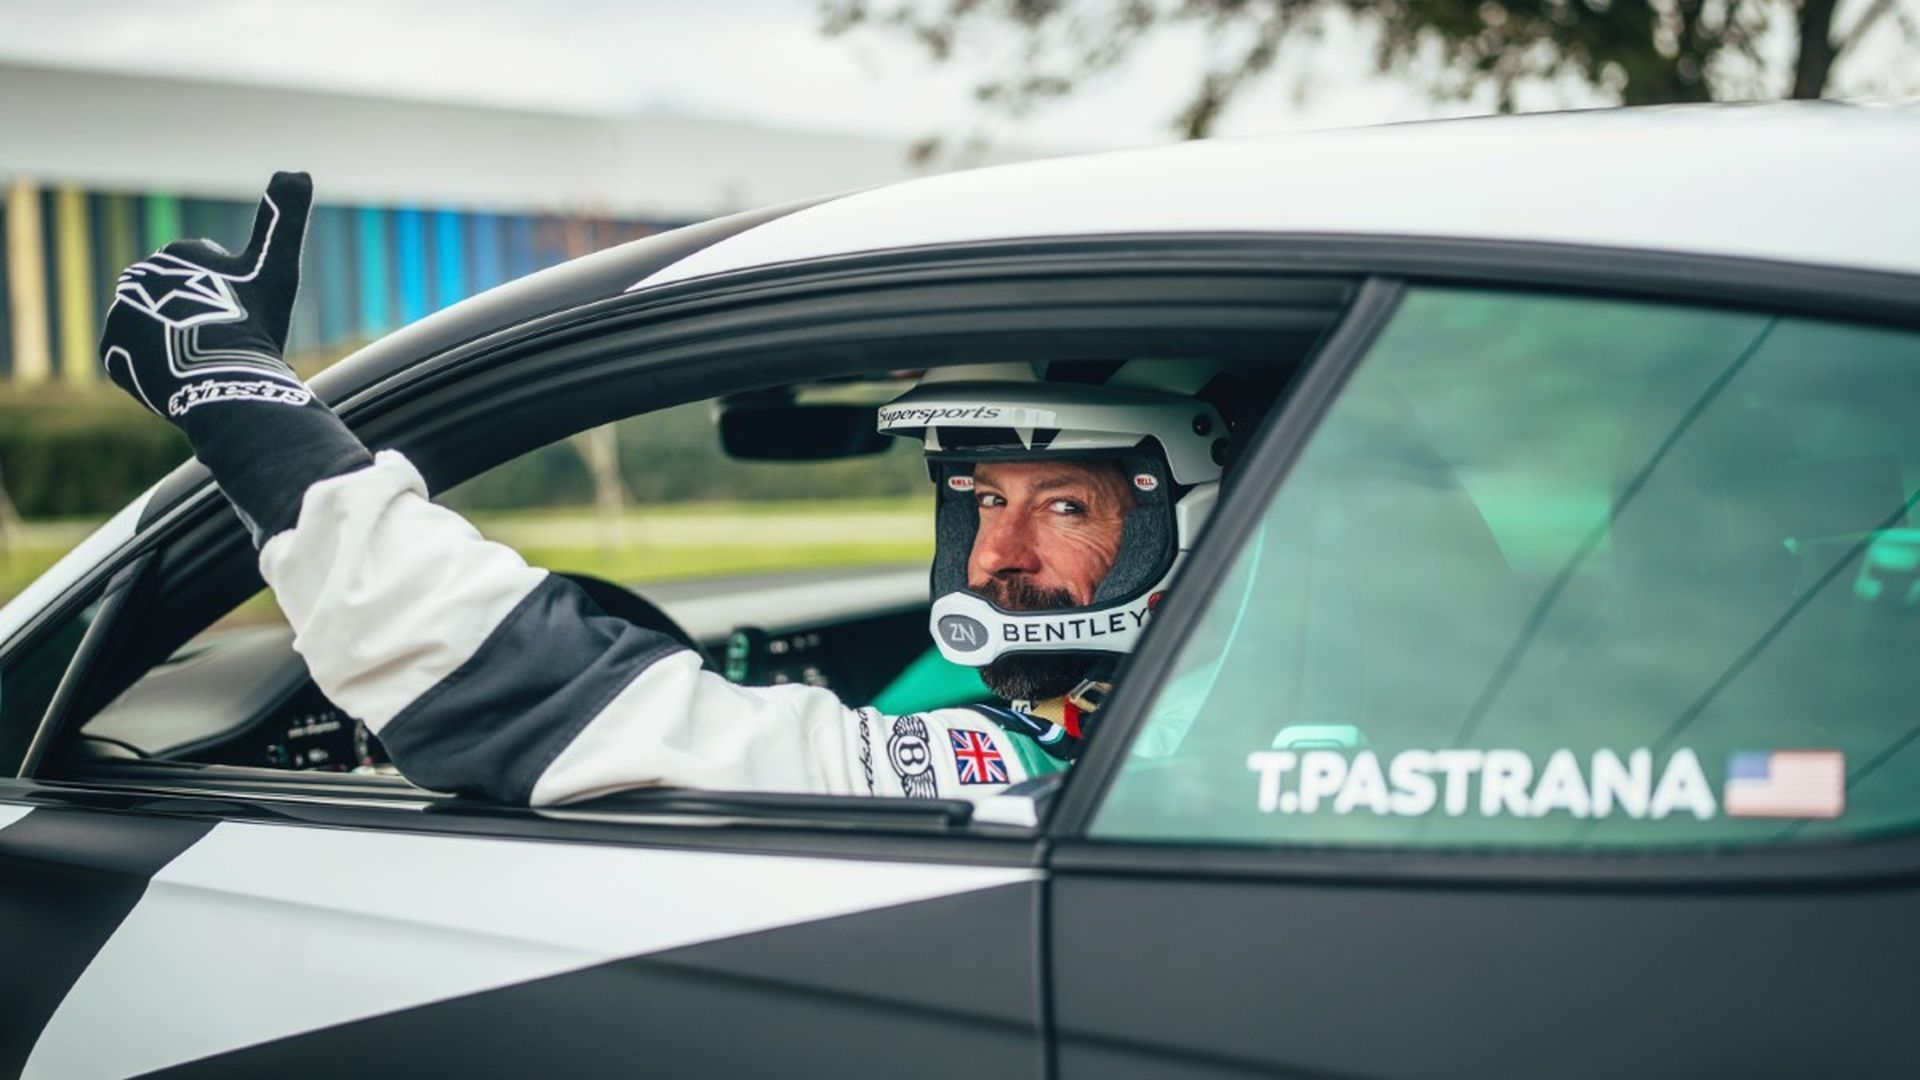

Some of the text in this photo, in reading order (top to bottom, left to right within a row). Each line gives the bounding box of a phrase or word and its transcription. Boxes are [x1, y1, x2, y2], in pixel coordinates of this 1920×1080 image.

[168, 379, 311, 416] alpinestars
[880, 406, 1001, 427] Supersports
[1003, 607, 1148, 643] BENTLEY
[1247, 747, 1716, 820] T.PASTRANA
